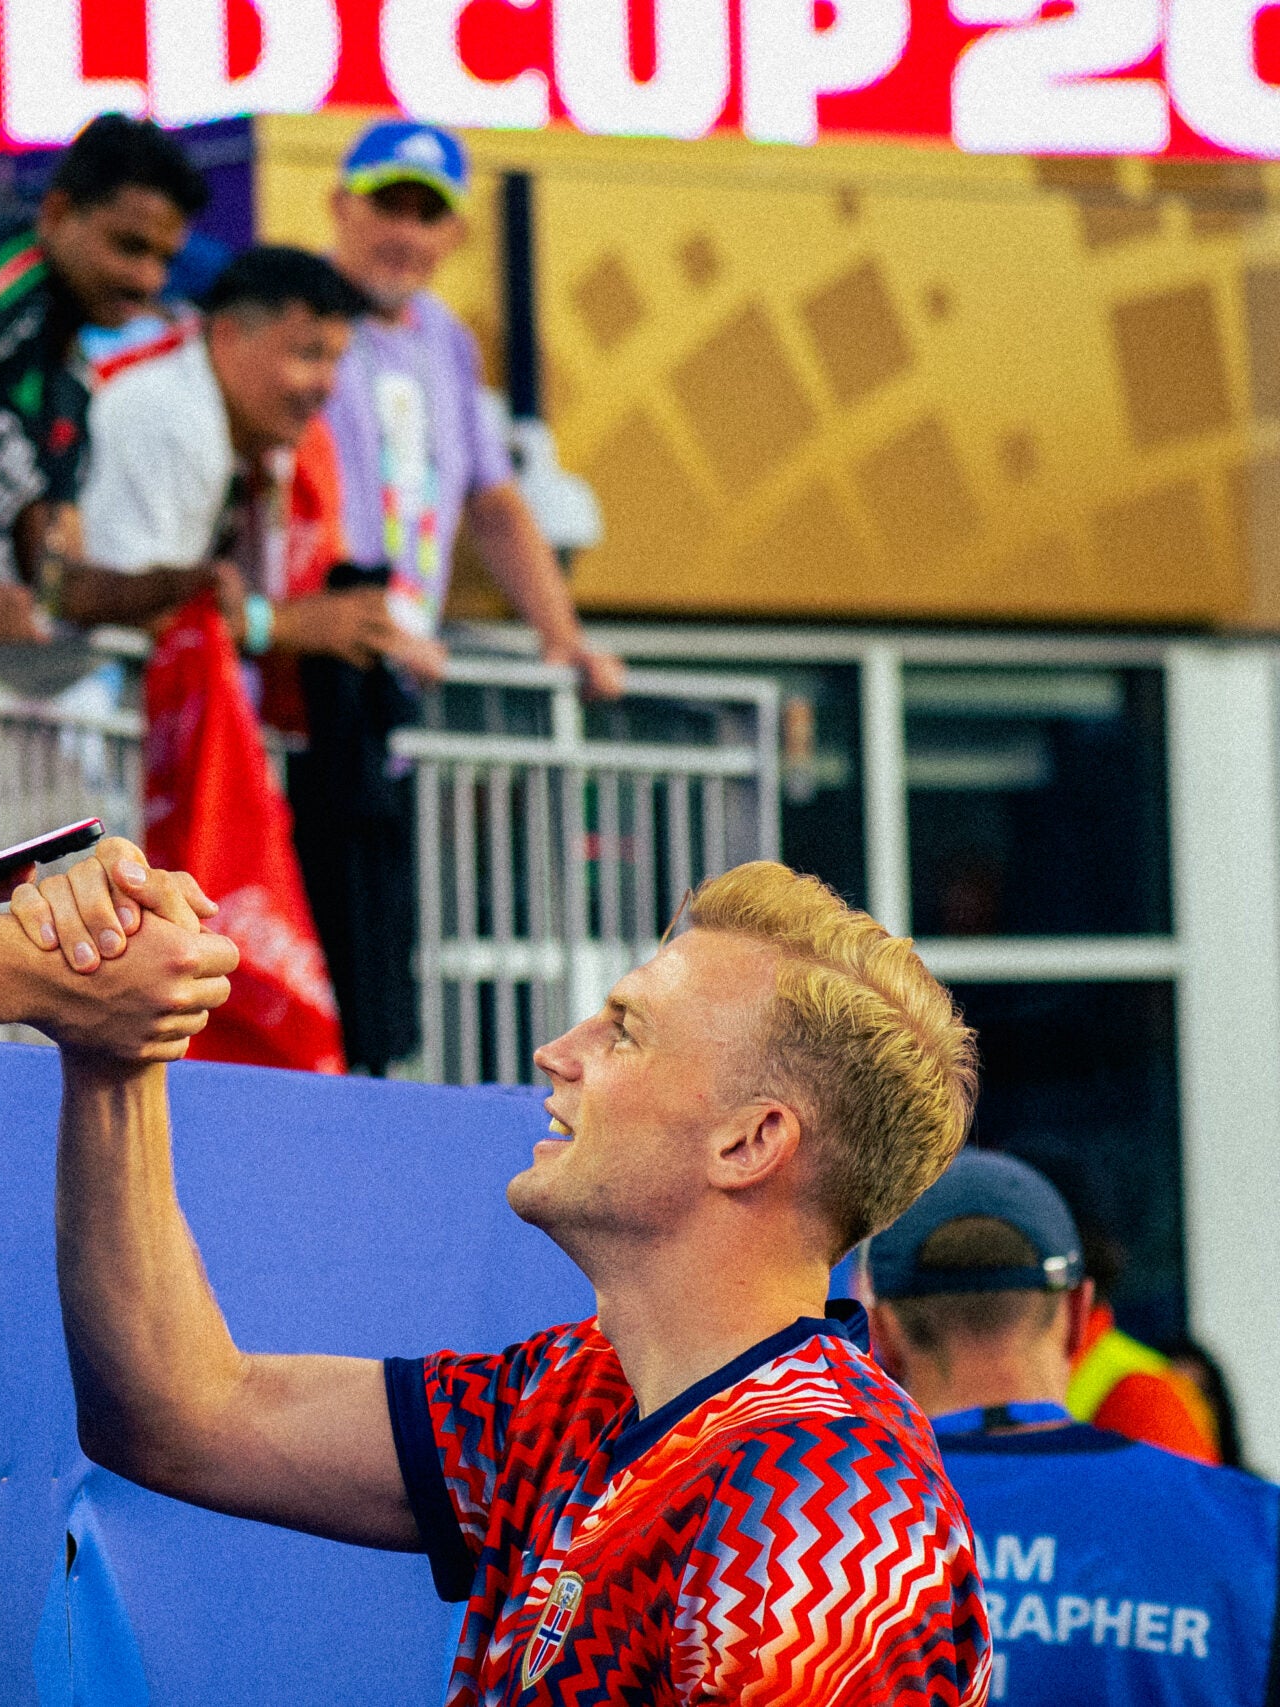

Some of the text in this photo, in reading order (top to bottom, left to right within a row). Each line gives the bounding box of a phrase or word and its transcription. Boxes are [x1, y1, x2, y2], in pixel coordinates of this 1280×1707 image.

[376, 0, 910, 146] CUP
[975, 1535, 1055, 1582] AM
[987, 1592, 1210, 1657] RAPHER
